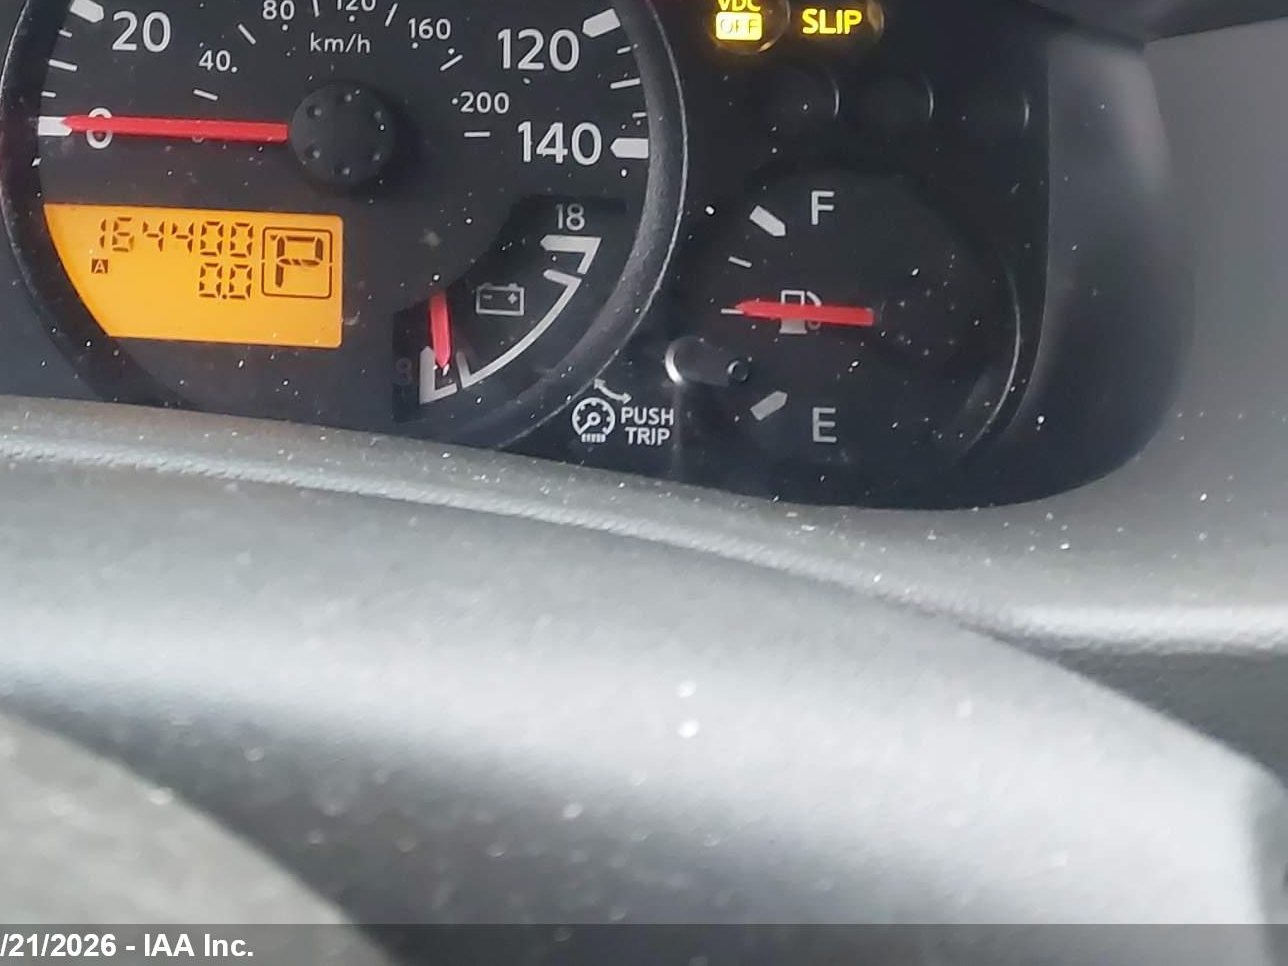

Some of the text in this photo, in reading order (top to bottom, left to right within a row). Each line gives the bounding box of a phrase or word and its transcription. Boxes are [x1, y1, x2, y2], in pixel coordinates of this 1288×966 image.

[262, 0, 295, 20] 80
[801, 8, 863, 35] SLIP
[112, 10, 171, 53] 20
[310, 32, 371, 54] km/h
[408, 18, 451, 40] 160
[198, 50, 231, 72] 40
[497, 28, 580, 72] 120
[460, 91, 510, 114] 200
[86, 107, 113, 149] 0
[517, 121, 602, 166] 140
[555, 203, 586, 231] 18
[811, 190, 835, 225] F
[99, 216, 253, 259] 164400
[91, 259, 108, 274] A
[269, 235, 324, 288] P
[198, 262, 253, 300] 0.0
[620, 406, 674, 427] PUSH
[812, 406, 837, 443] E
[624, 426, 670, 446] TRIP
